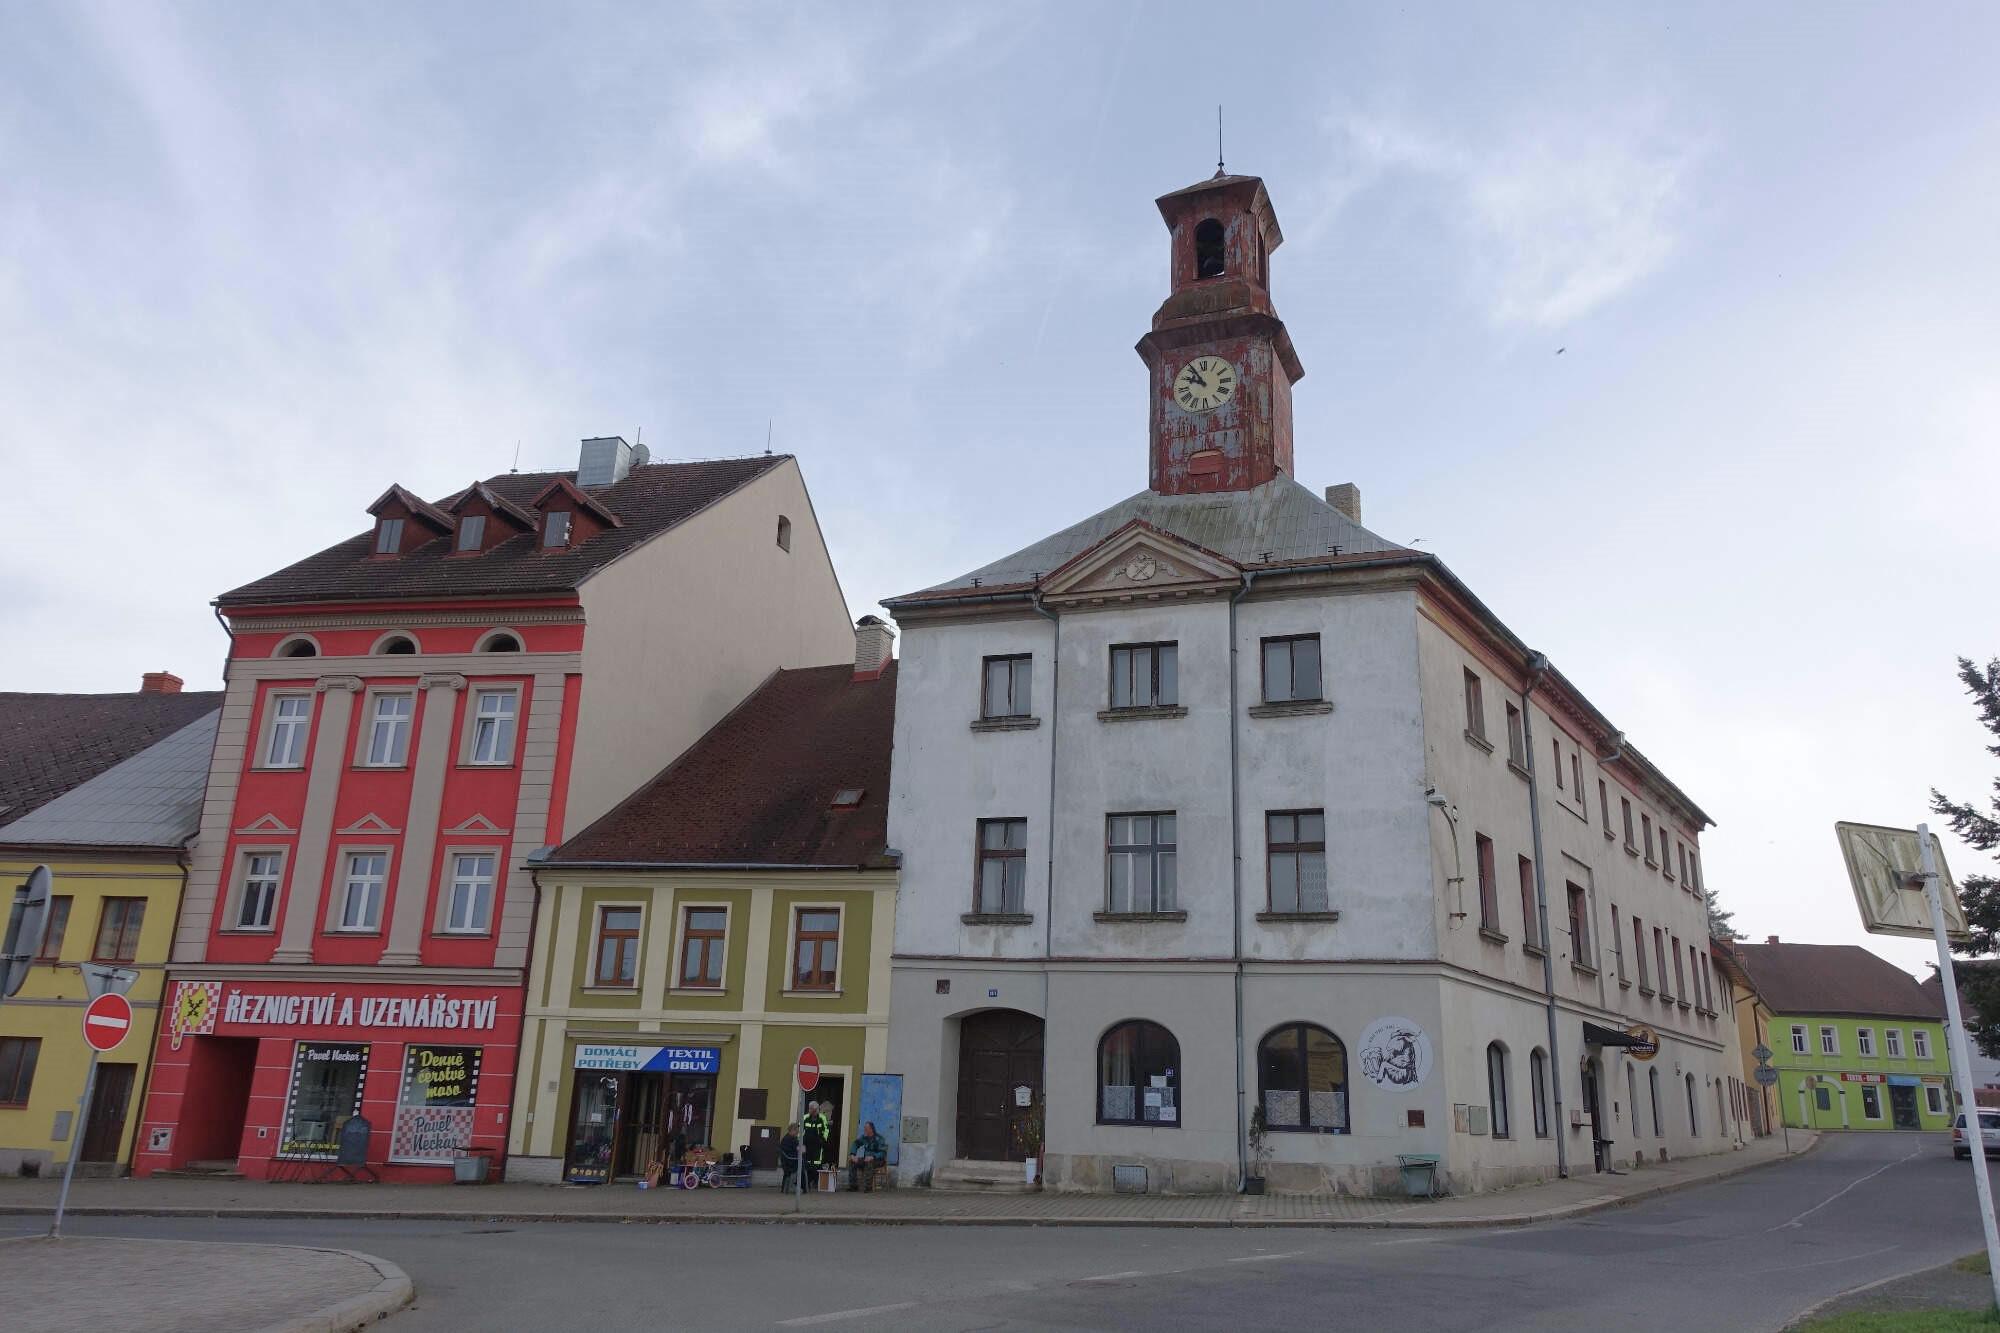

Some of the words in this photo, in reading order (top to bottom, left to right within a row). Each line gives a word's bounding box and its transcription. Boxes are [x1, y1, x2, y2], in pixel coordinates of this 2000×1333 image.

[223, 989, 336, 1023] ŘEZNICTVÍ
[337, 997, 353, 1026] A
[359, 993, 498, 1029] UZENÁŘSTVÍ
[308, 1049, 331, 1061] Pavel
[584, 1046, 637, 1057] DOMÁCÍ
[667, 1049, 714, 1059] TEXTIL
[577, 1058, 641, 1069] POTŘEBY
[670, 1061, 710, 1070] OBUV
[417, 1066, 467, 1084] čerstvé
[426, 1084, 462, 1099] maso
[414, 1115, 453, 1134] Pavel
